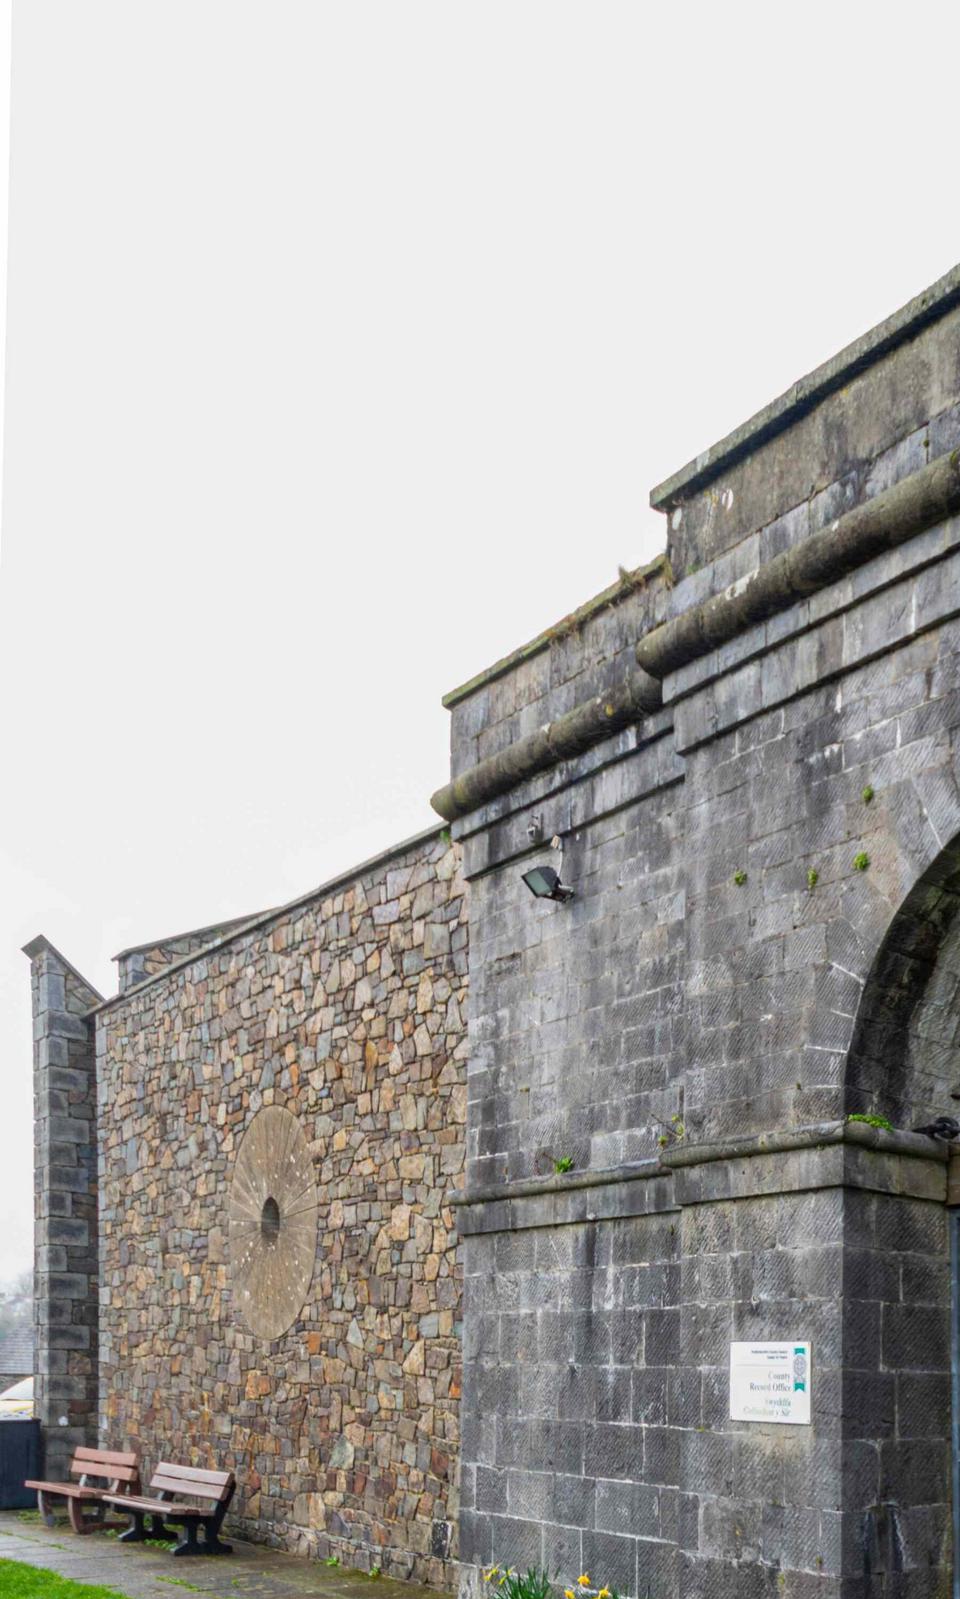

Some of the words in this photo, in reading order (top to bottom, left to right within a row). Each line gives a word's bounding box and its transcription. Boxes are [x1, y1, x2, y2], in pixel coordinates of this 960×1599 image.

[767, 1370, 790, 1382] County
[749, 1382, 771, 1391] Record
[772, 1382, 791, 1392] Office
